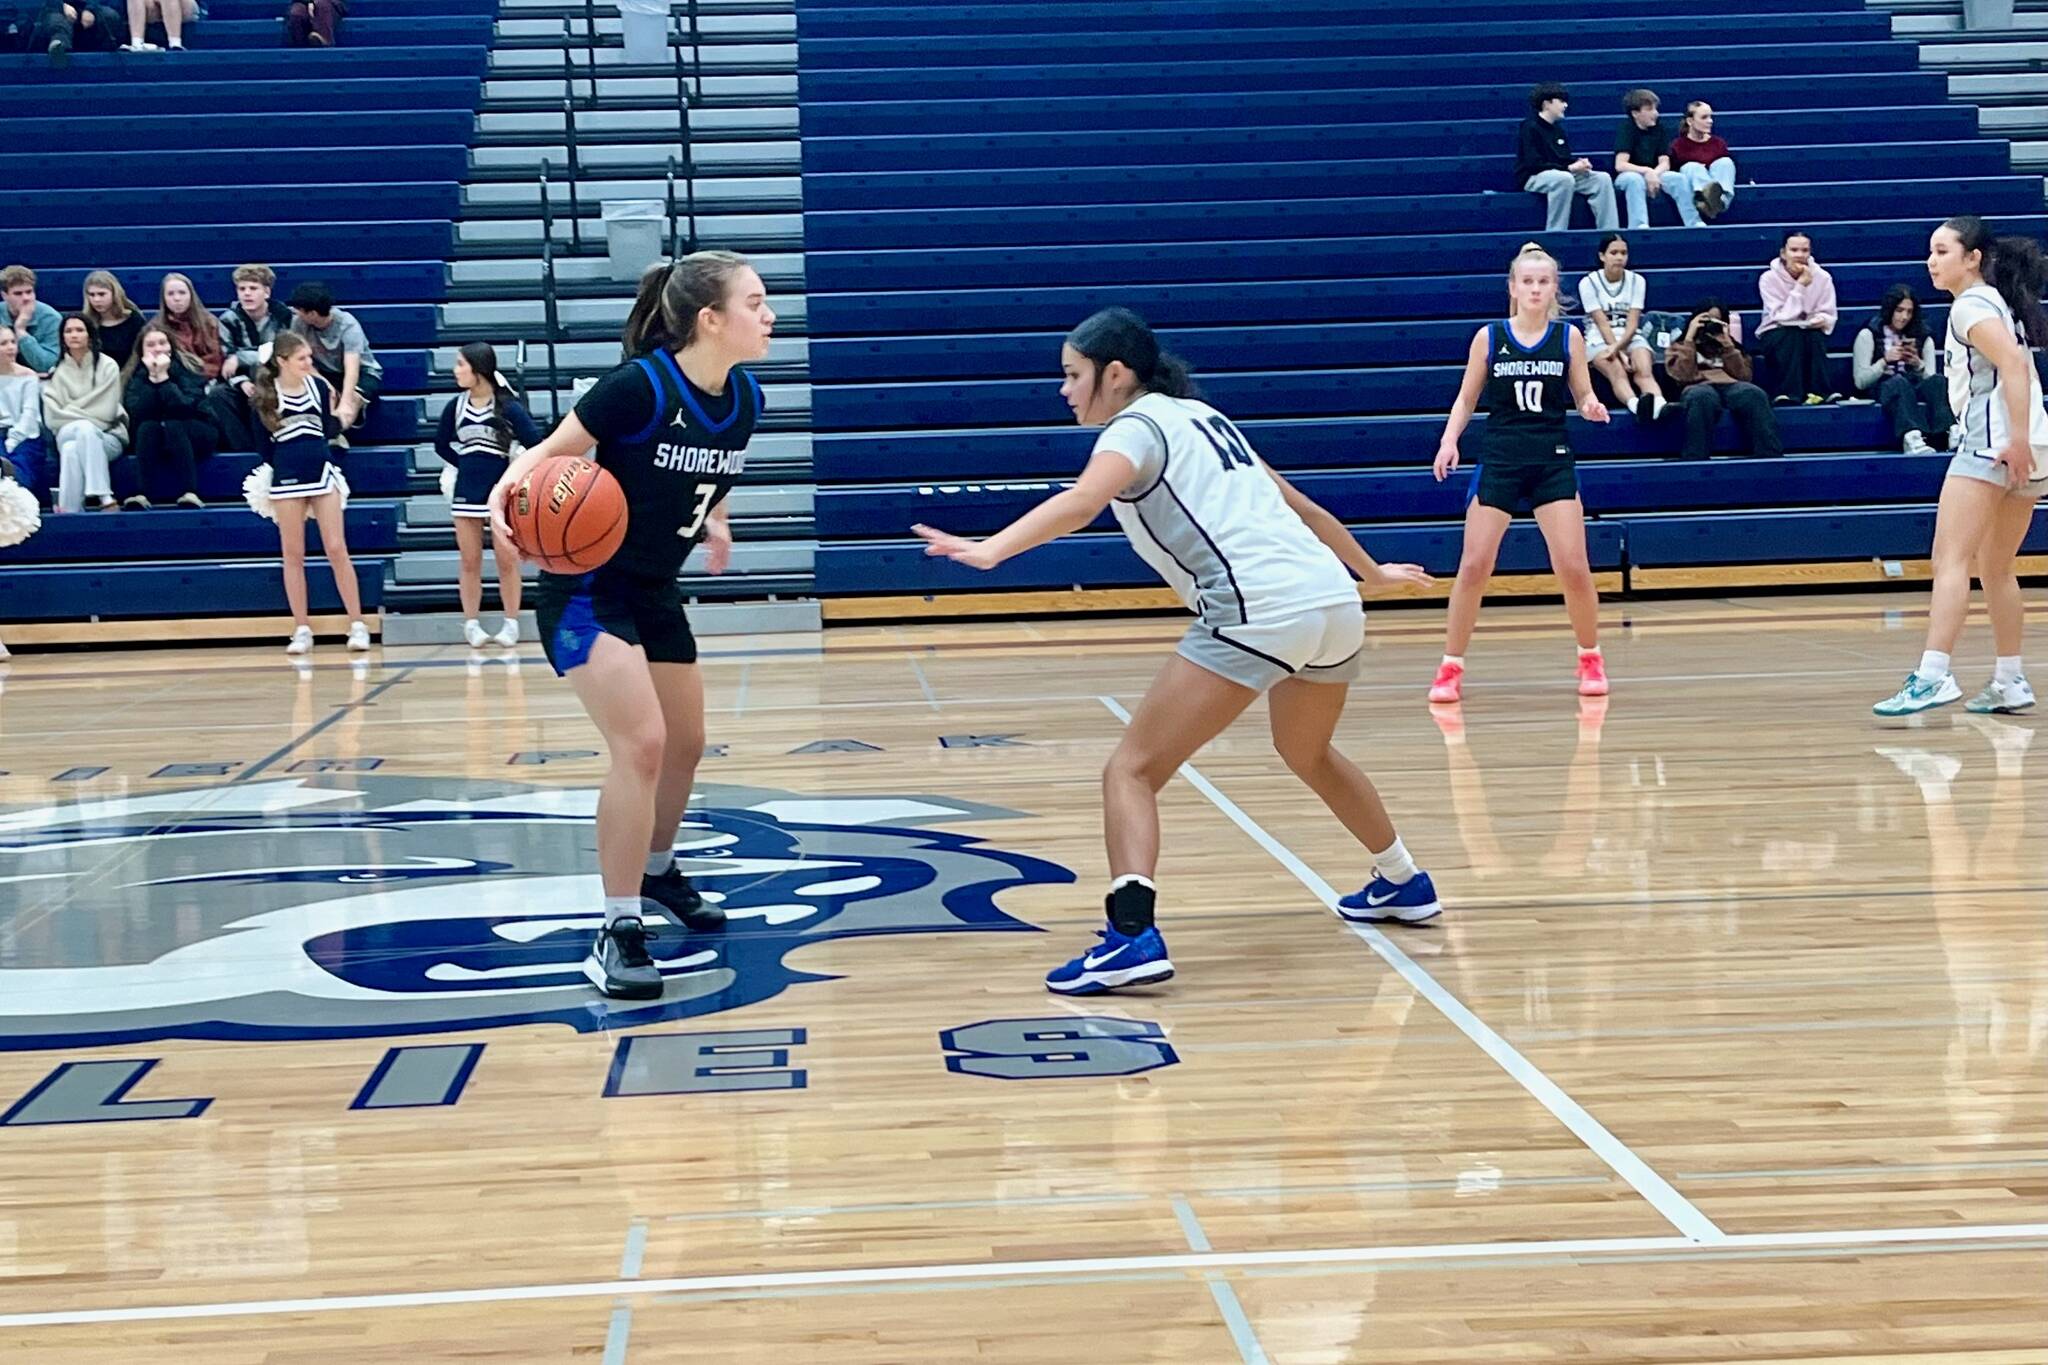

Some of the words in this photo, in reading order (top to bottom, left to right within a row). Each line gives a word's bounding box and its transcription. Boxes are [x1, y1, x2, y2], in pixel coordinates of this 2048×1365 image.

[1493, 360, 1565, 378] SHOREWOOD
[1513, 380, 1544, 413] 10
[1190, 414, 1255, 472] 10
[676, 483, 717, 538] 3
